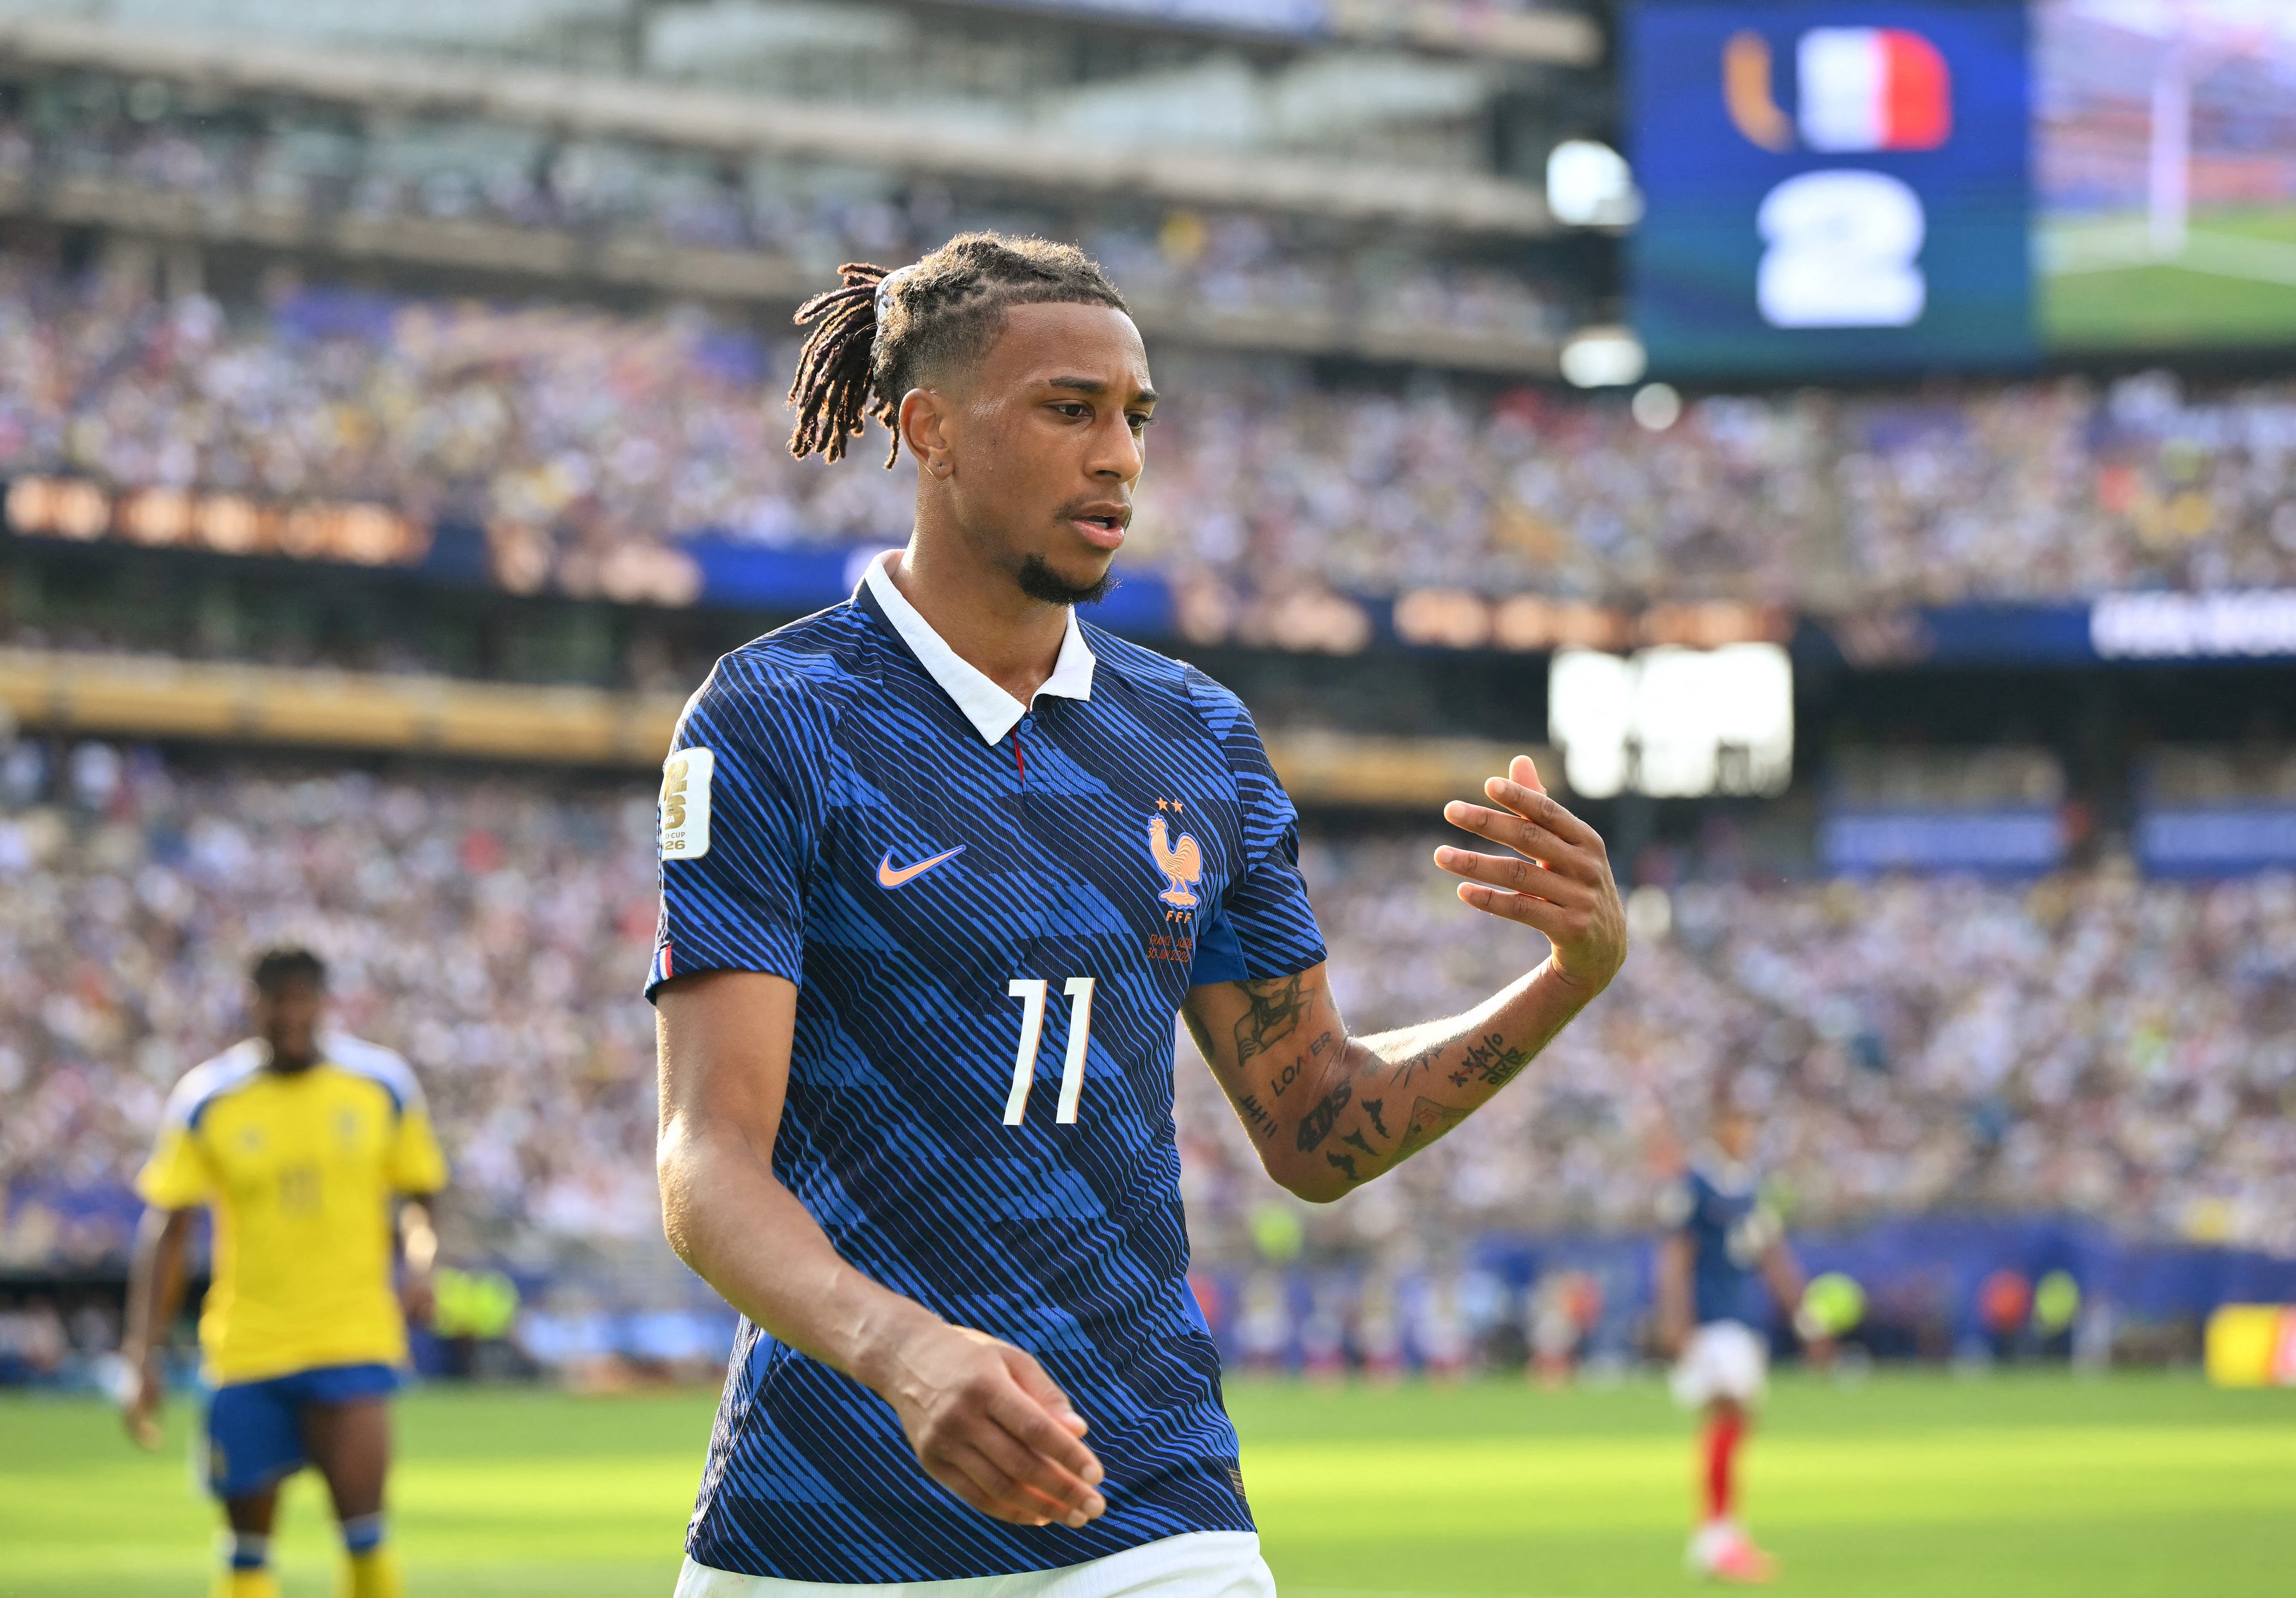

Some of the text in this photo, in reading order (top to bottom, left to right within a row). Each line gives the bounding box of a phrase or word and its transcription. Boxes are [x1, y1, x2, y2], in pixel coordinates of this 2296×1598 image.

[1757, 169, 1925, 328] 2
[662, 840, 685, 850] 26
[1166, 910, 1192, 924] FFF
[1146, 947, 1158, 959] 30
[1170, 949, 1190, 962] 2026
[1003, 977, 1095, 1126] 11
